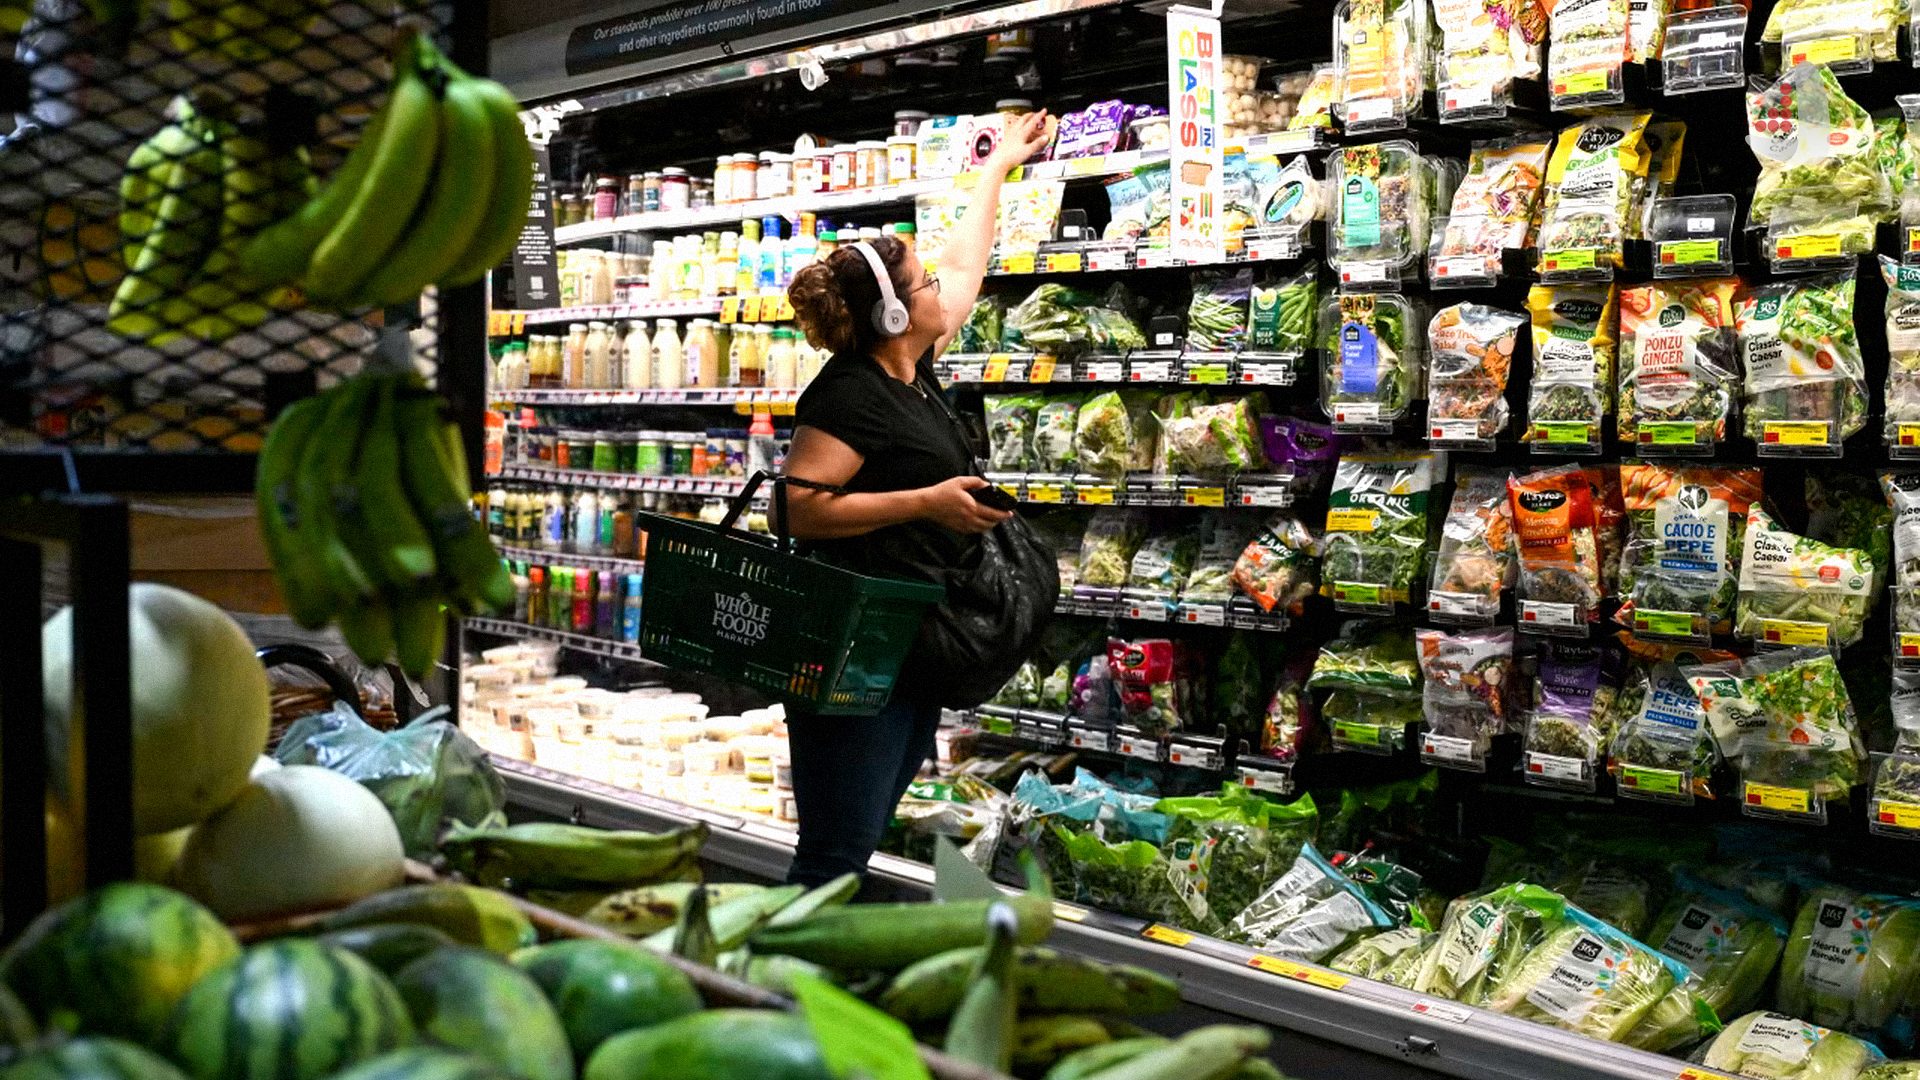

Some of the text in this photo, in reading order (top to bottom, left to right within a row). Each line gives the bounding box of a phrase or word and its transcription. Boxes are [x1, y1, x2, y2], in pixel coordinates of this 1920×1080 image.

[593, 27, 610, 41] Our
[610, 17, 649, 37] standards
[684, 4, 704, 18] over
[619, 38, 634, 53] and
[635, 34, 657, 49] other
[658, 22, 706, 45] ingredients
[707, 9, 755, 32] commonly
[757, 4, 785, 20] found
[787, 0, 797, 13] in
[1179, 29, 1198, 147] CLASS
[1197, 31, 1215, 147] BEST IN
[1433, 340, 1457, 350] Salad
[1644, 335, 1684, 352] PONZU
[1748, 337, 1782, 352] Classic
[1641, 350, 1685, 366] GINGER
[1750, 350, 1783, 363] Caesar
[1523, 490, 1565, 502] Taylor
[1663, 523, 1716, 539] CACIO E
[1664, 539, 1715, 554] PEPE
[1753, 551, 1788, 562] Caesar
[714, 592, 772, 624] WHOLE
[712, 609, 767, 640] FOODS
[716, 629, 756, 647] MARKET
[1653, 690, 1700, 711] PEPE
[1824, 907, 1843, 920] 365
[1577, 942, 1598, 957] 365
[1813, 939, 1852, 956] Hearts of
[1811, 948, 1846, 965] Romaine
[1555, 965, 1594, 988] Hearts of
